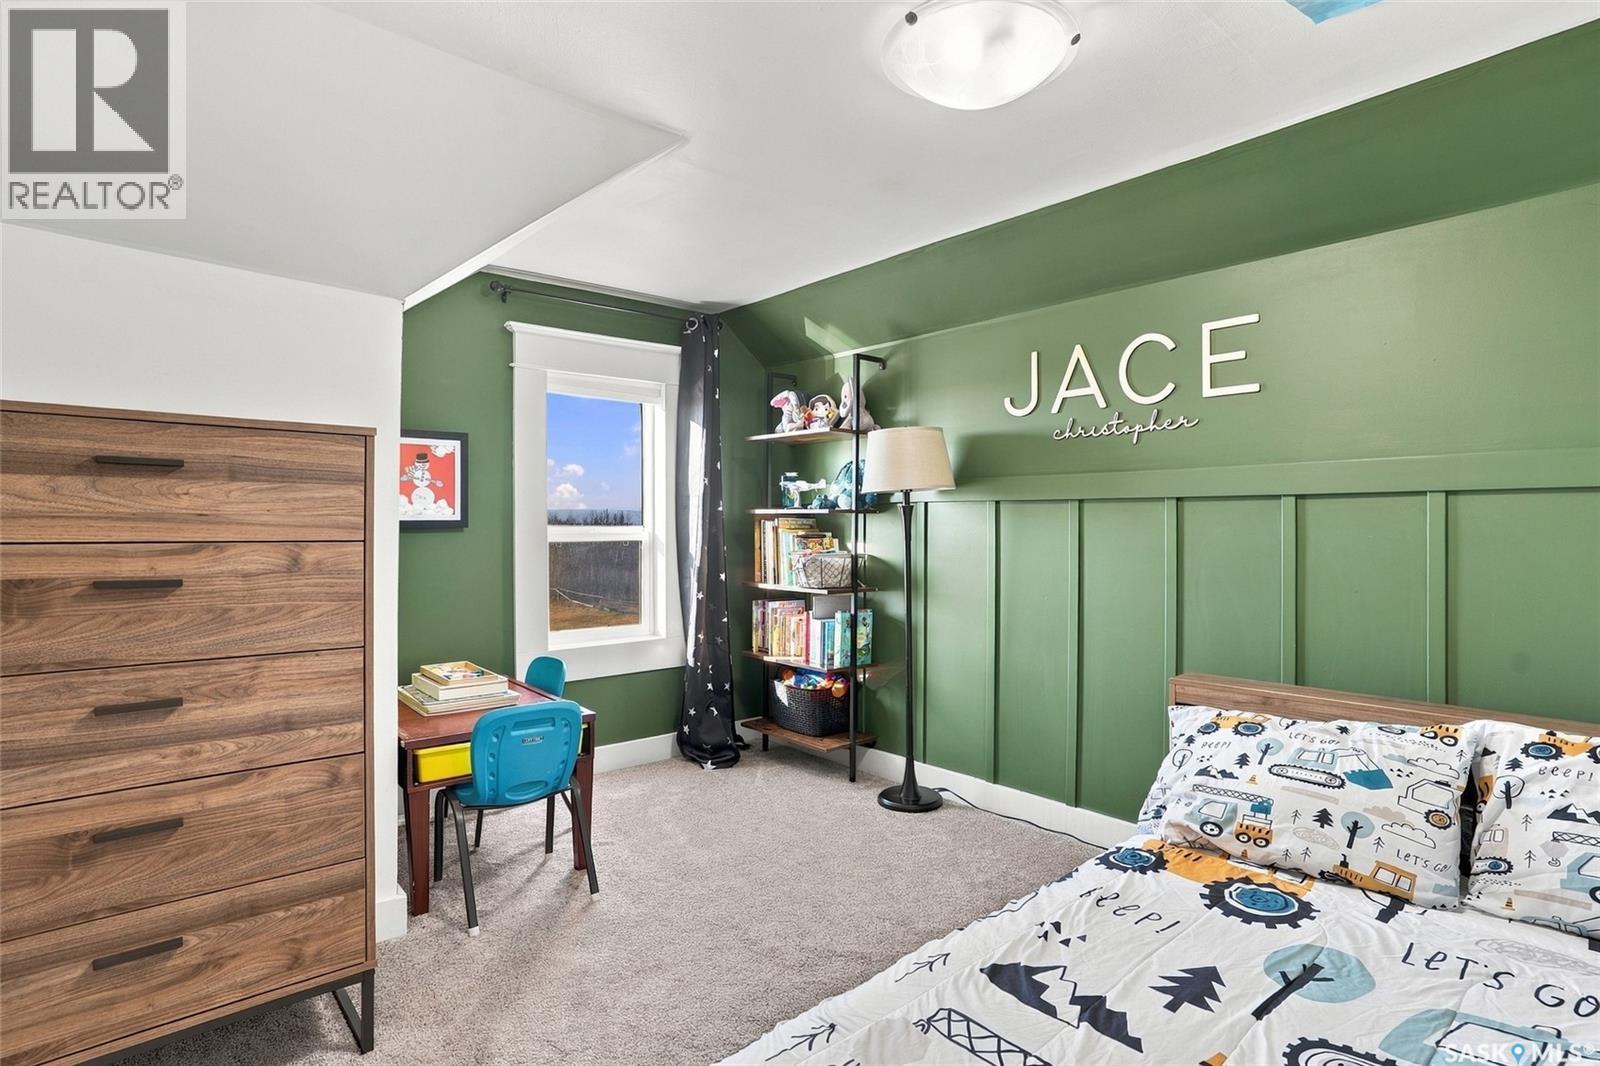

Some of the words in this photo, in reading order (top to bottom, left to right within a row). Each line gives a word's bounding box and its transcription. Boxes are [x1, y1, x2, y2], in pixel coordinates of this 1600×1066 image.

[1004, 313, 1261, 417] JACE
[1053, 408, 1200, 445] christopher
[1534, 983, 1600, 1018] GO
